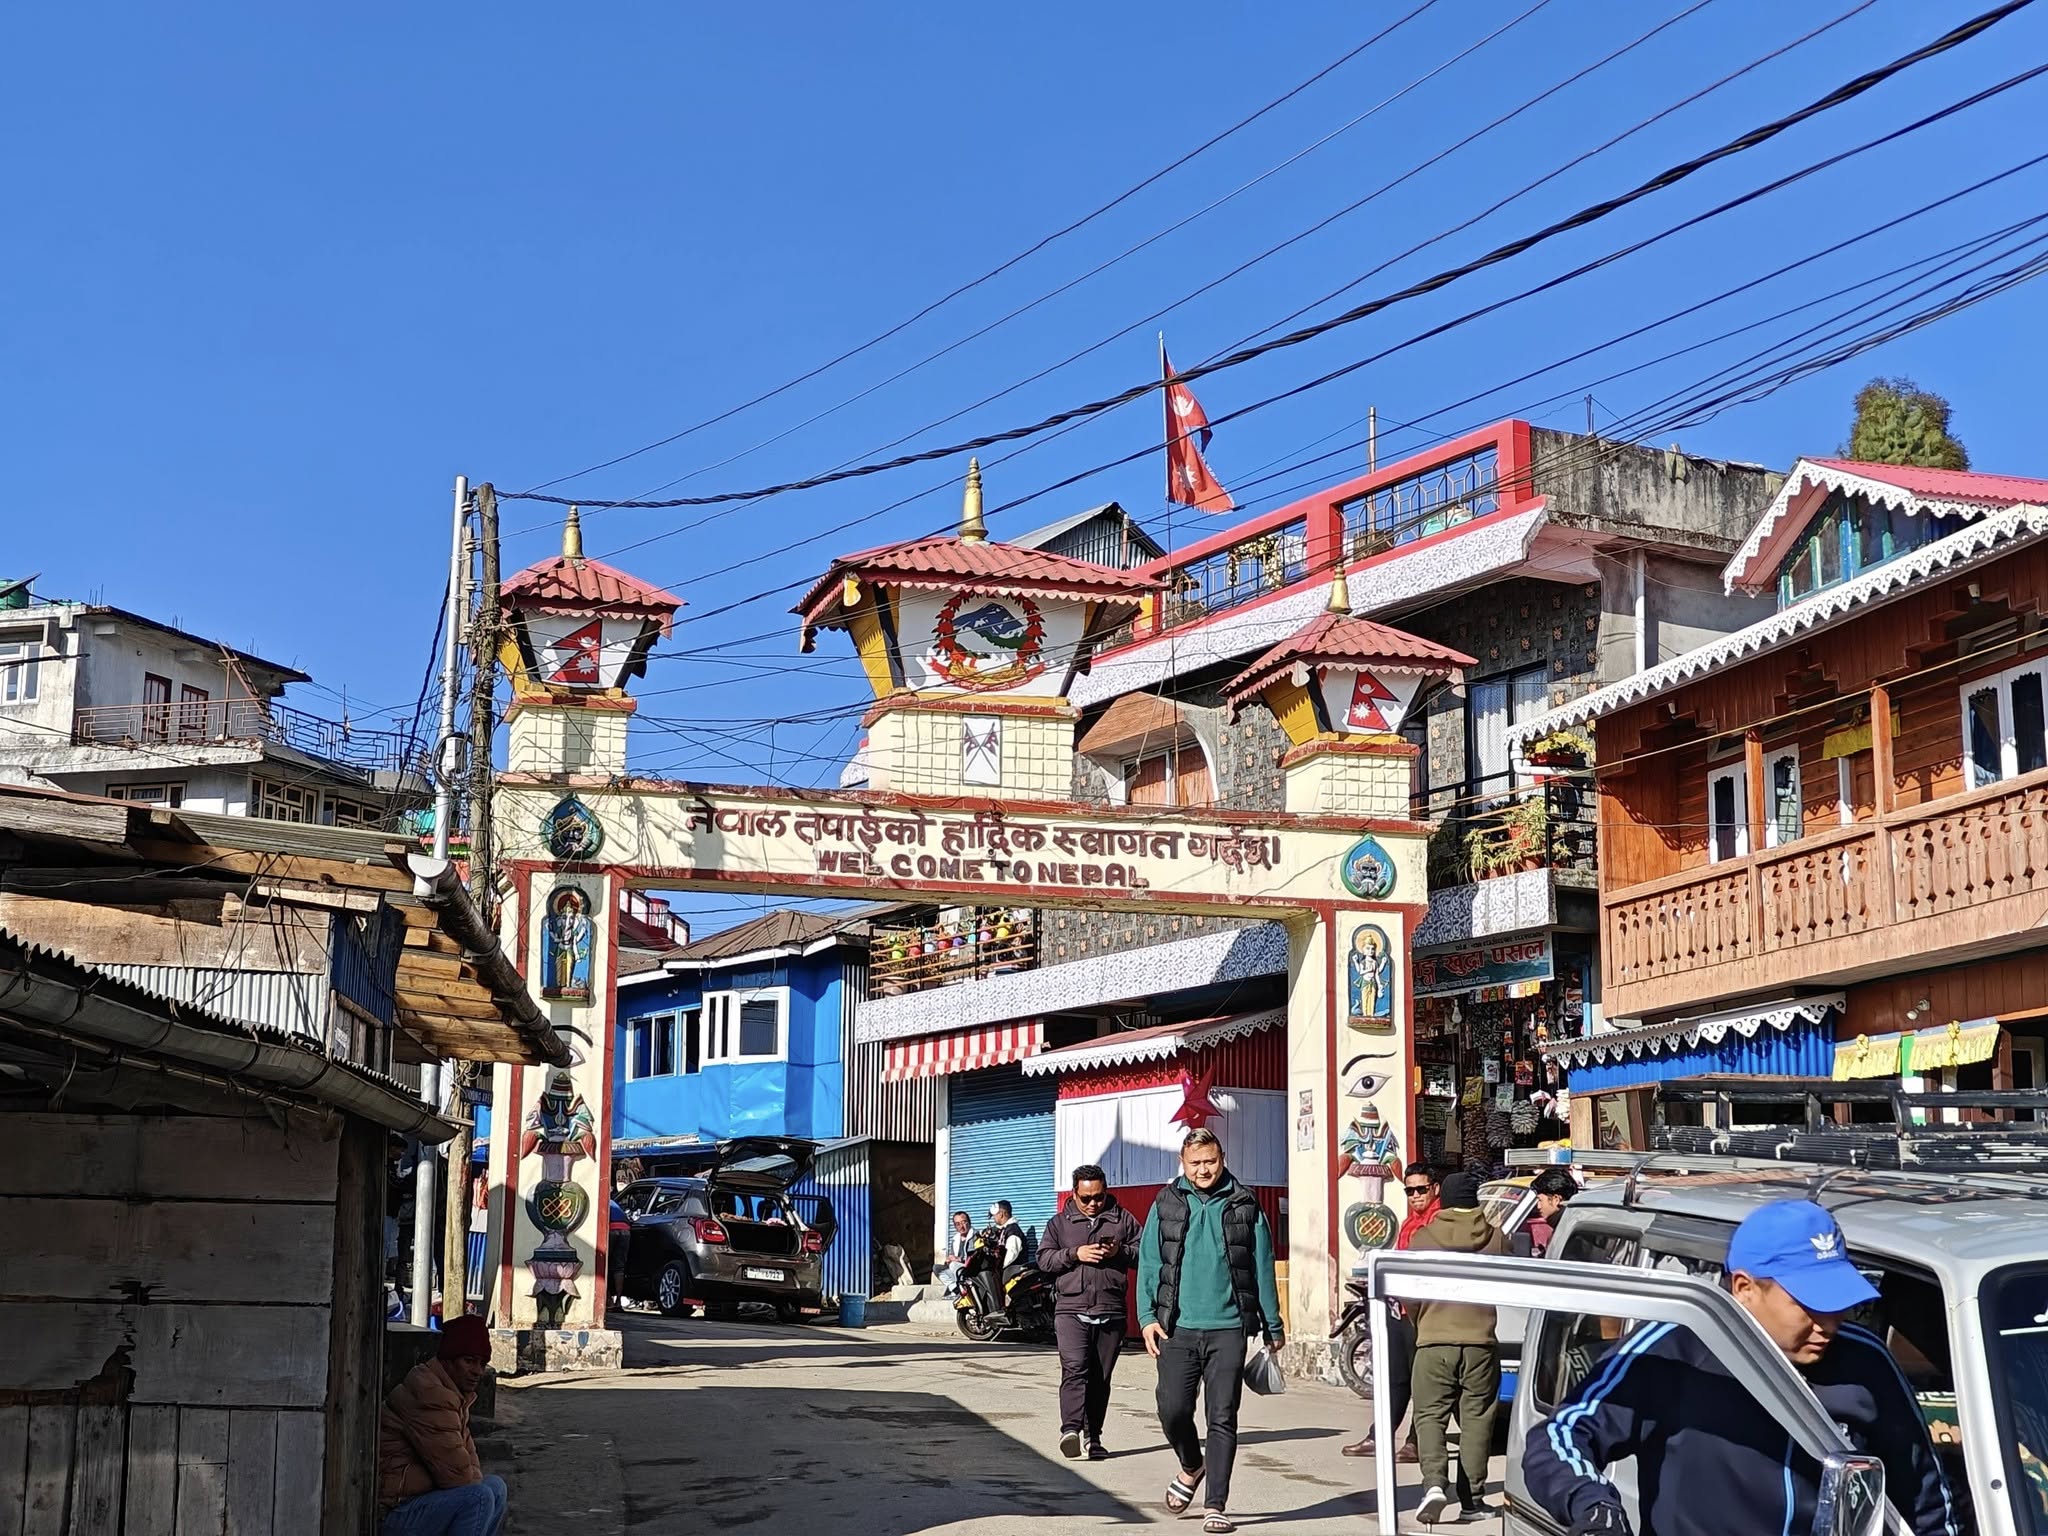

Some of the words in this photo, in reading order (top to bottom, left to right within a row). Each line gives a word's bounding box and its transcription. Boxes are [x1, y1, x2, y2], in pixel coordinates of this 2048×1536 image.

[686, 796, 791, 838] नेपाल
[1053, 826, 1185, 860] स्वागत
[992, 860, 1033, 884] TO
[1038, 861, 1150, 889] NEPAL
